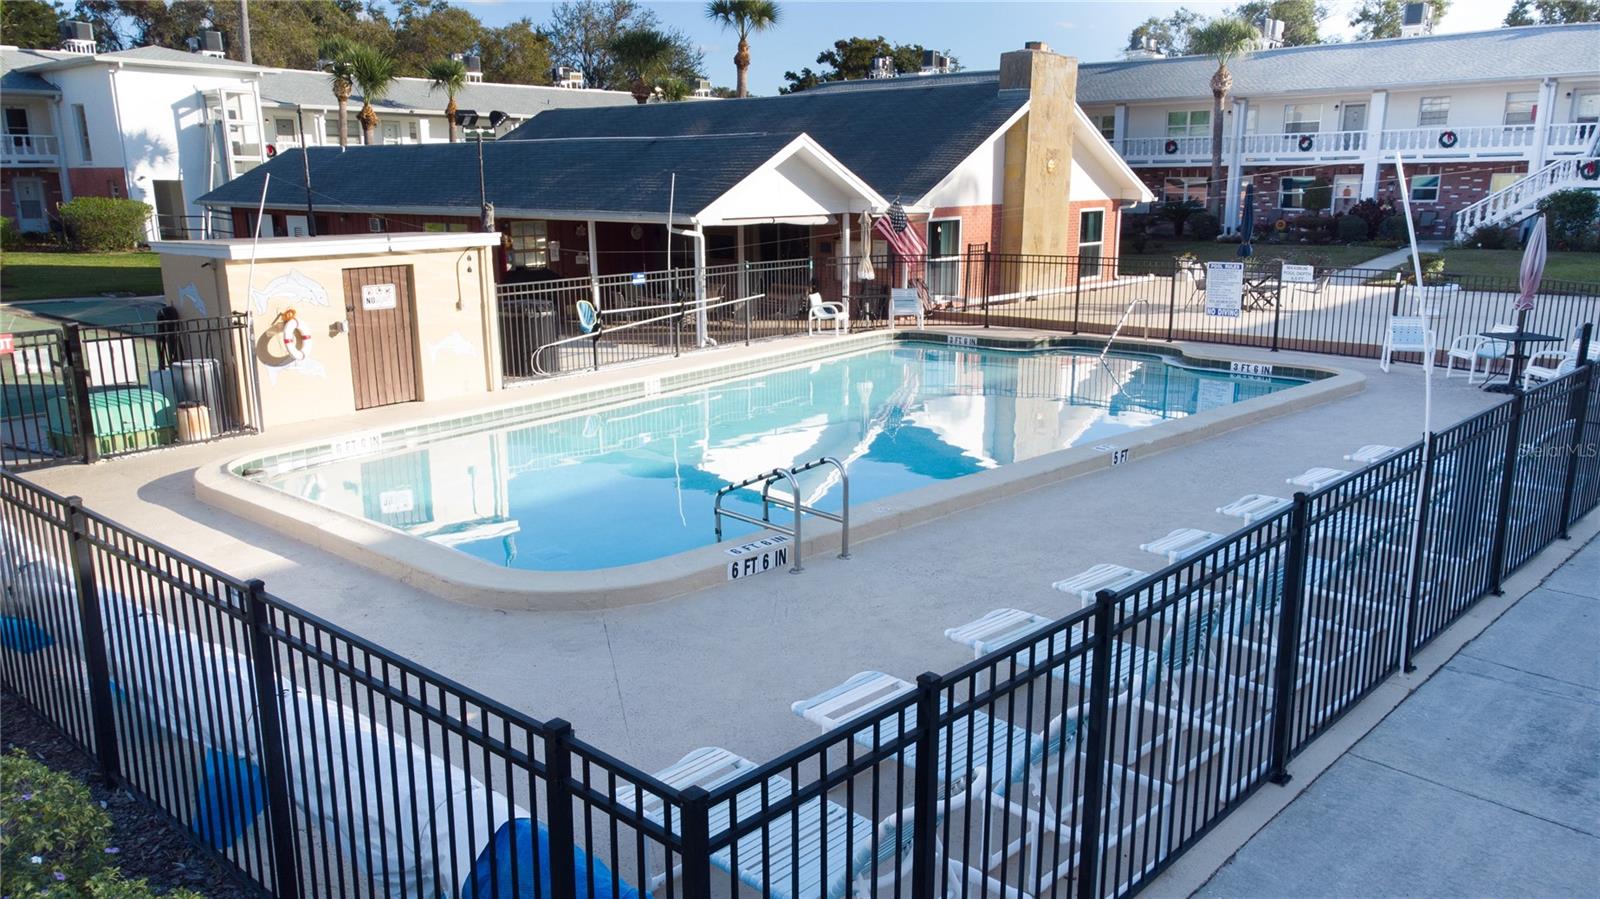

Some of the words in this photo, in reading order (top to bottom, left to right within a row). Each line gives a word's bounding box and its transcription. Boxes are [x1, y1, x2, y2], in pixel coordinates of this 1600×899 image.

[1217, 308, 1239, 317] DIVING
[1233, 362, 1239, 371] 3
[1241, 363, 1250, 373] FT
[1253, 364, 1259, 374] 6
[1261, 365, 1271, 375] IN
[1113, 451, 1119, 465] 5
[1120, 448, 1129, 463] FT
[742, 543, 760, 552] FT
[772, 535, 788, 543] IN
[731, 561, 739, 579] 6
[744, 556, 758, 576] FT
[762, 553, 770, 570] 6
[774, 547, 787, 568] IN
